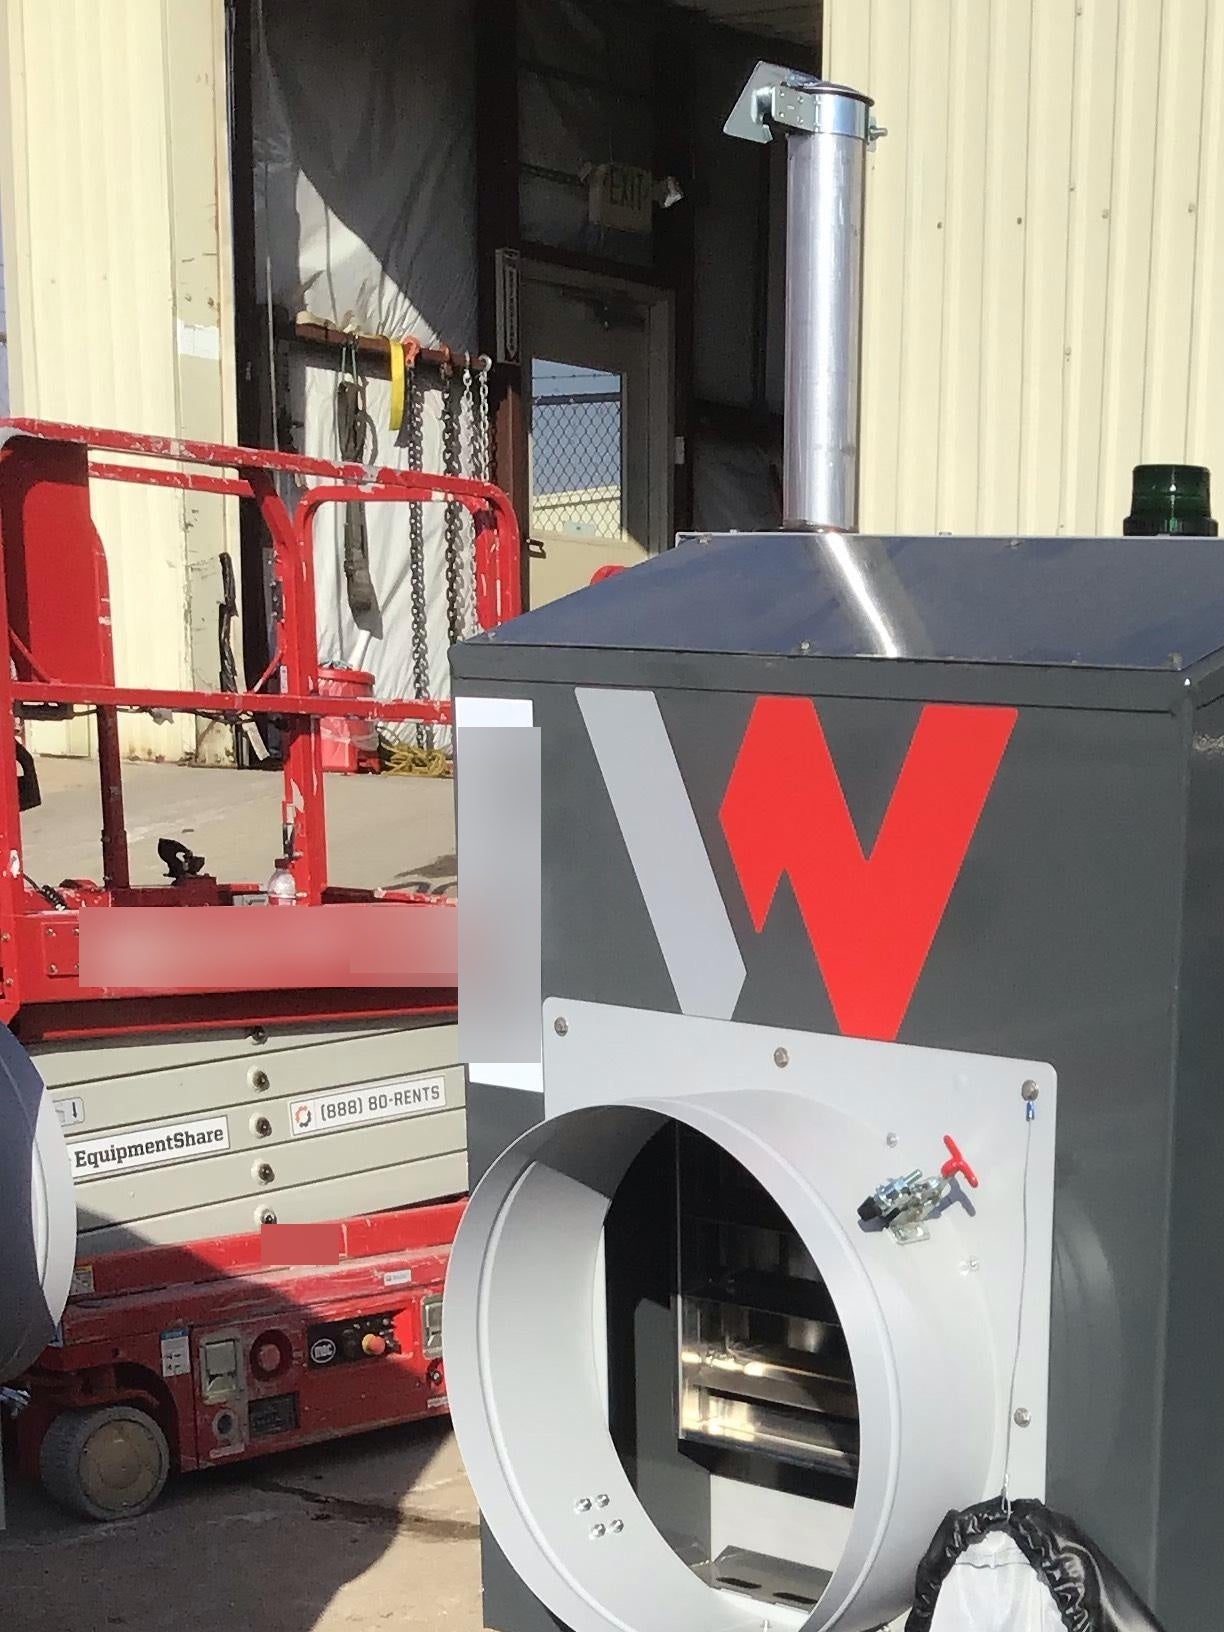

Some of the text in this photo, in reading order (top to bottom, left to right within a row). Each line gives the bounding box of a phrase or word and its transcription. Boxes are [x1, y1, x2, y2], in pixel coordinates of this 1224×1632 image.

[320, 1085, 440, 1121] (888) 80-RENTS
[74, 1128, 224, 1168] EquipmentShare
